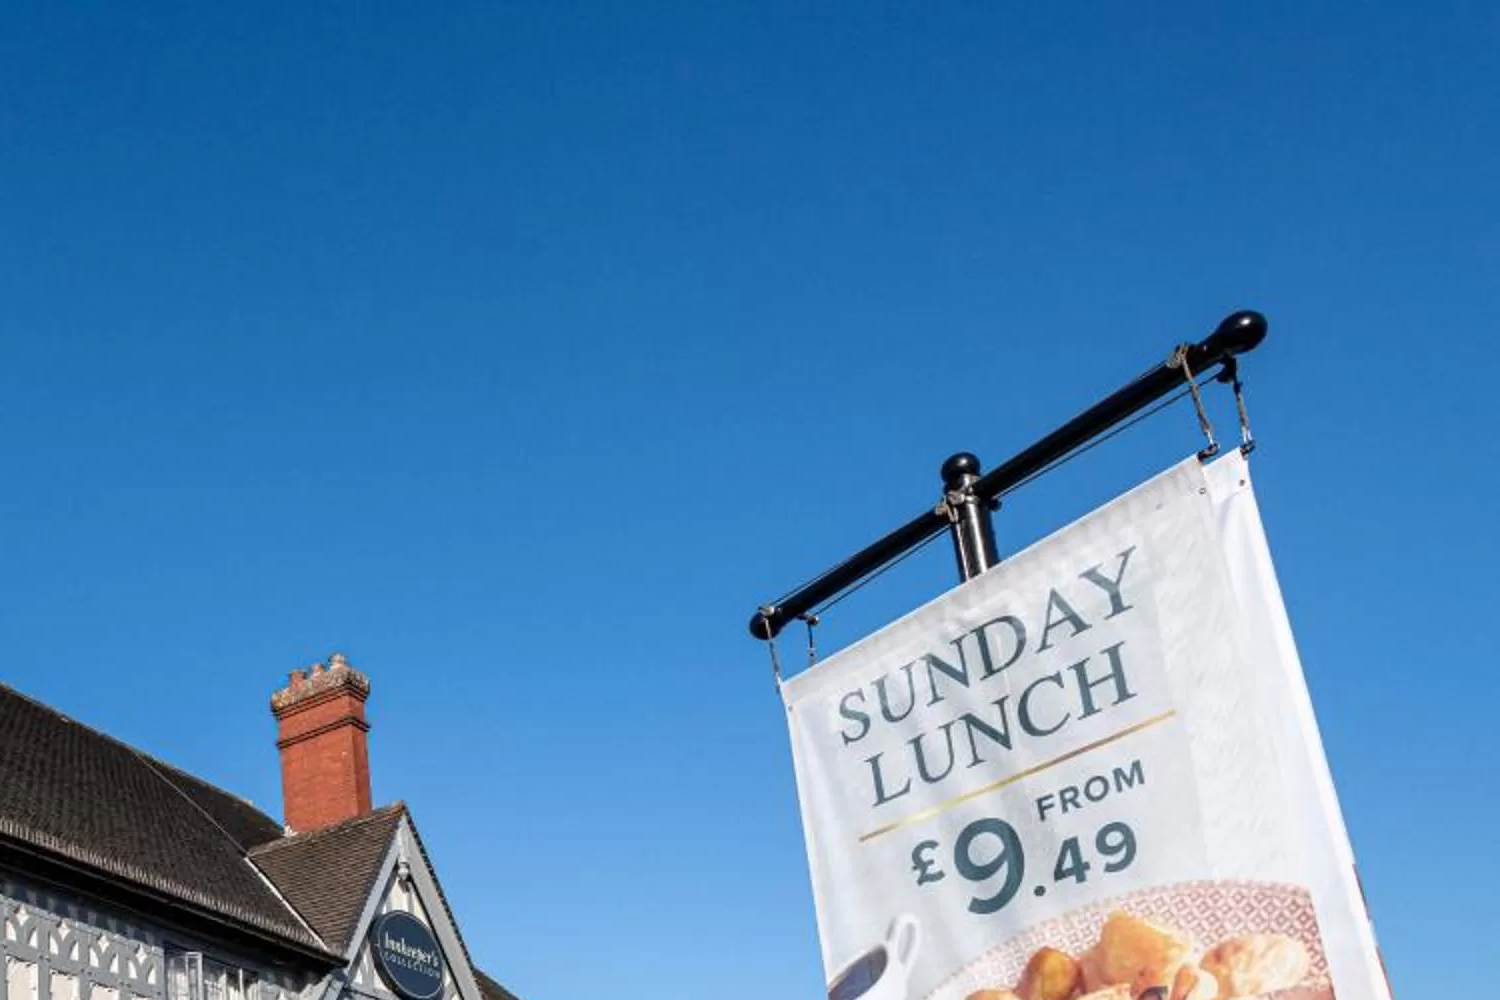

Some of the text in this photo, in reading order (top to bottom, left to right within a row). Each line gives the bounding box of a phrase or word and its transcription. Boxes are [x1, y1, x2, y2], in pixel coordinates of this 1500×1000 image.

[838, 545, 1138, 746] SUNDAY
[864, 641, 1139, 807] LUNCH
[1035, 759, 1146, 822] FROM
[910, 817, 1138, 915] £9.49
